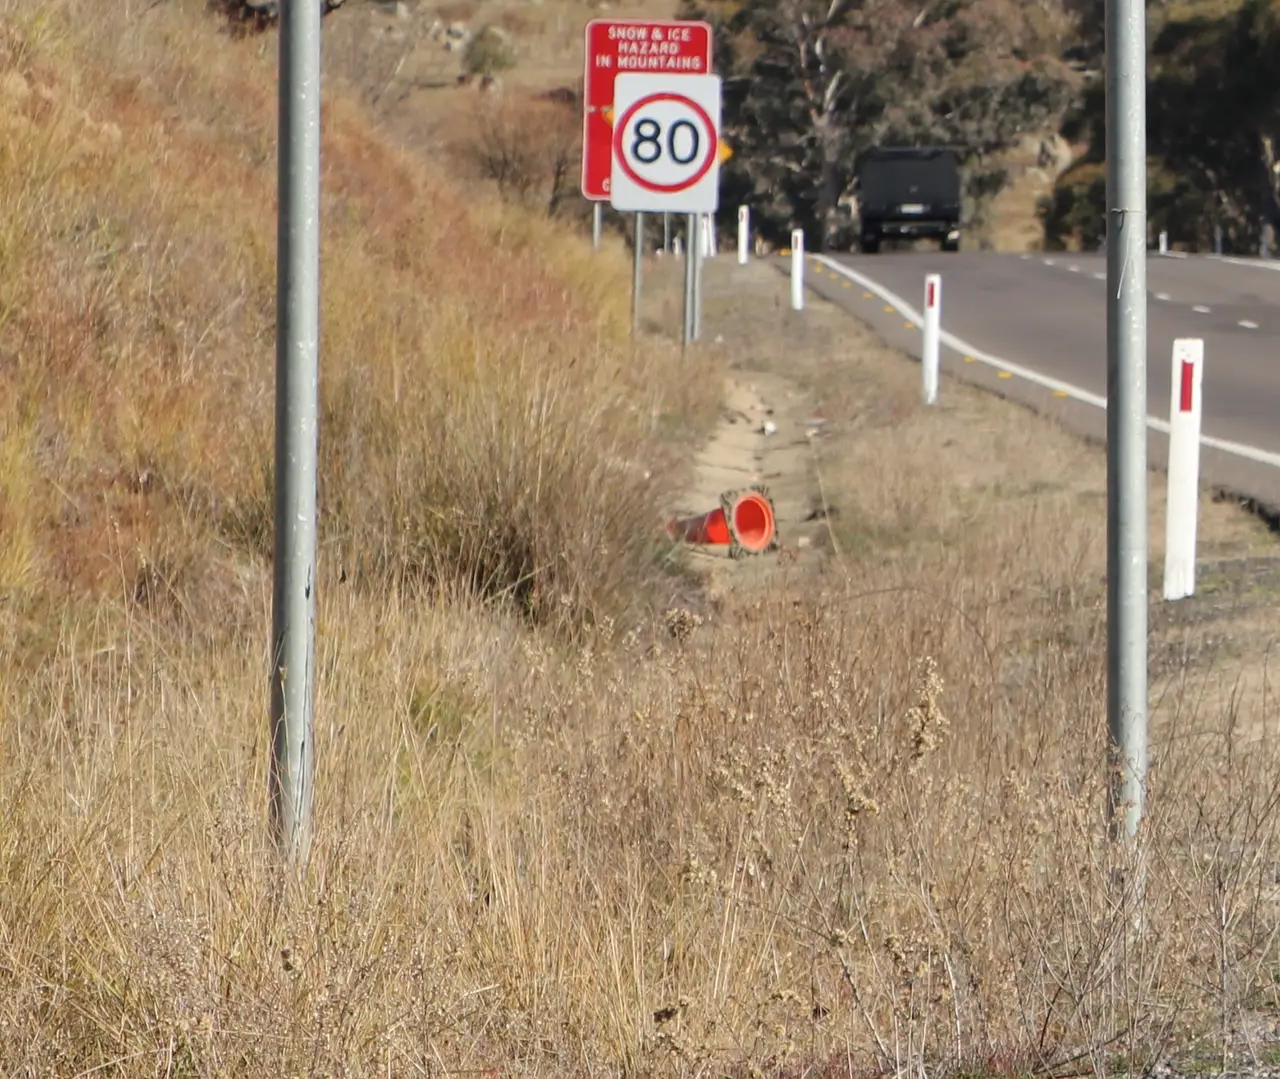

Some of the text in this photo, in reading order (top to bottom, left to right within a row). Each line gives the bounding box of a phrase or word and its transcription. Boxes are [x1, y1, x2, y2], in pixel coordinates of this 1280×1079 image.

[607, 25, 691, 42] SNOW & ICE
[618, 41, 679, 55] HAZARD
[595, 54, 701, 69] IN MOUNTAINS
[632, 118, 700, 165] 80
